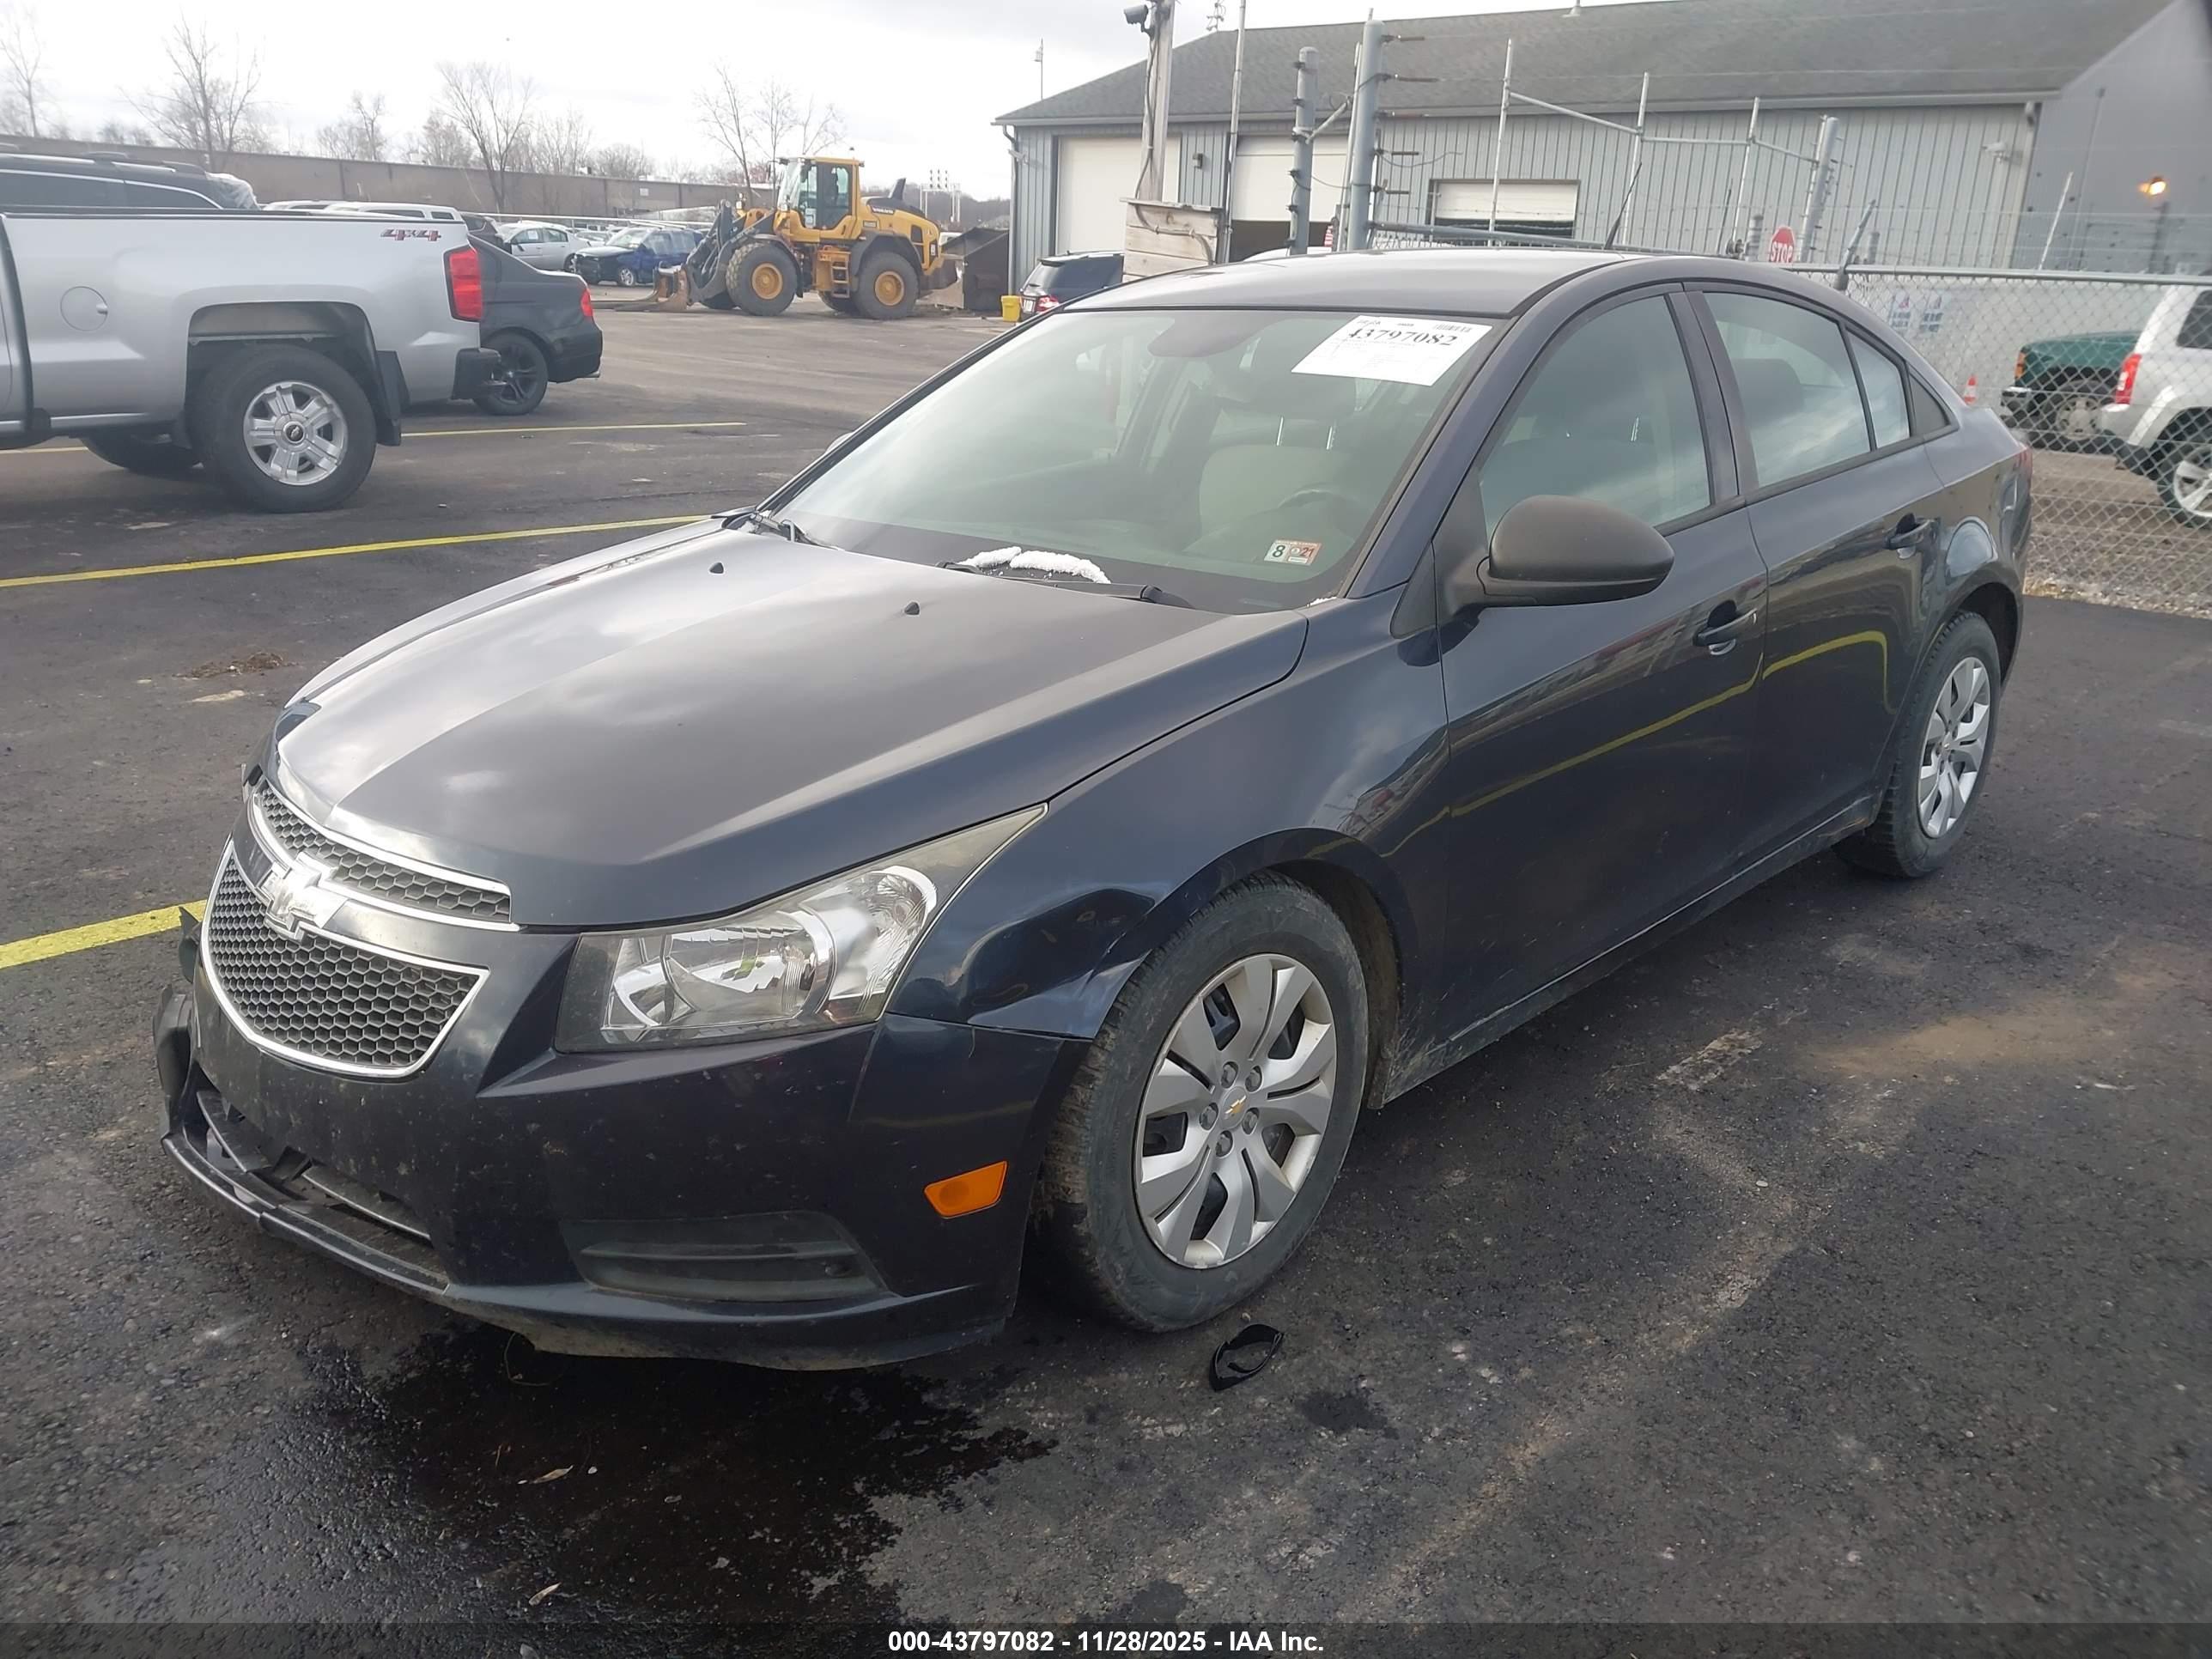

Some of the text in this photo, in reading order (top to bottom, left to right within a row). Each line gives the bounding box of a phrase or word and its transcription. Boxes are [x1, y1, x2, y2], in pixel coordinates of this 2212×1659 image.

[1771, 240, 1794, 263] STOP
[1348, 328, 1458, 346] 43797082
[1272, 544, 1286, 558] 8
